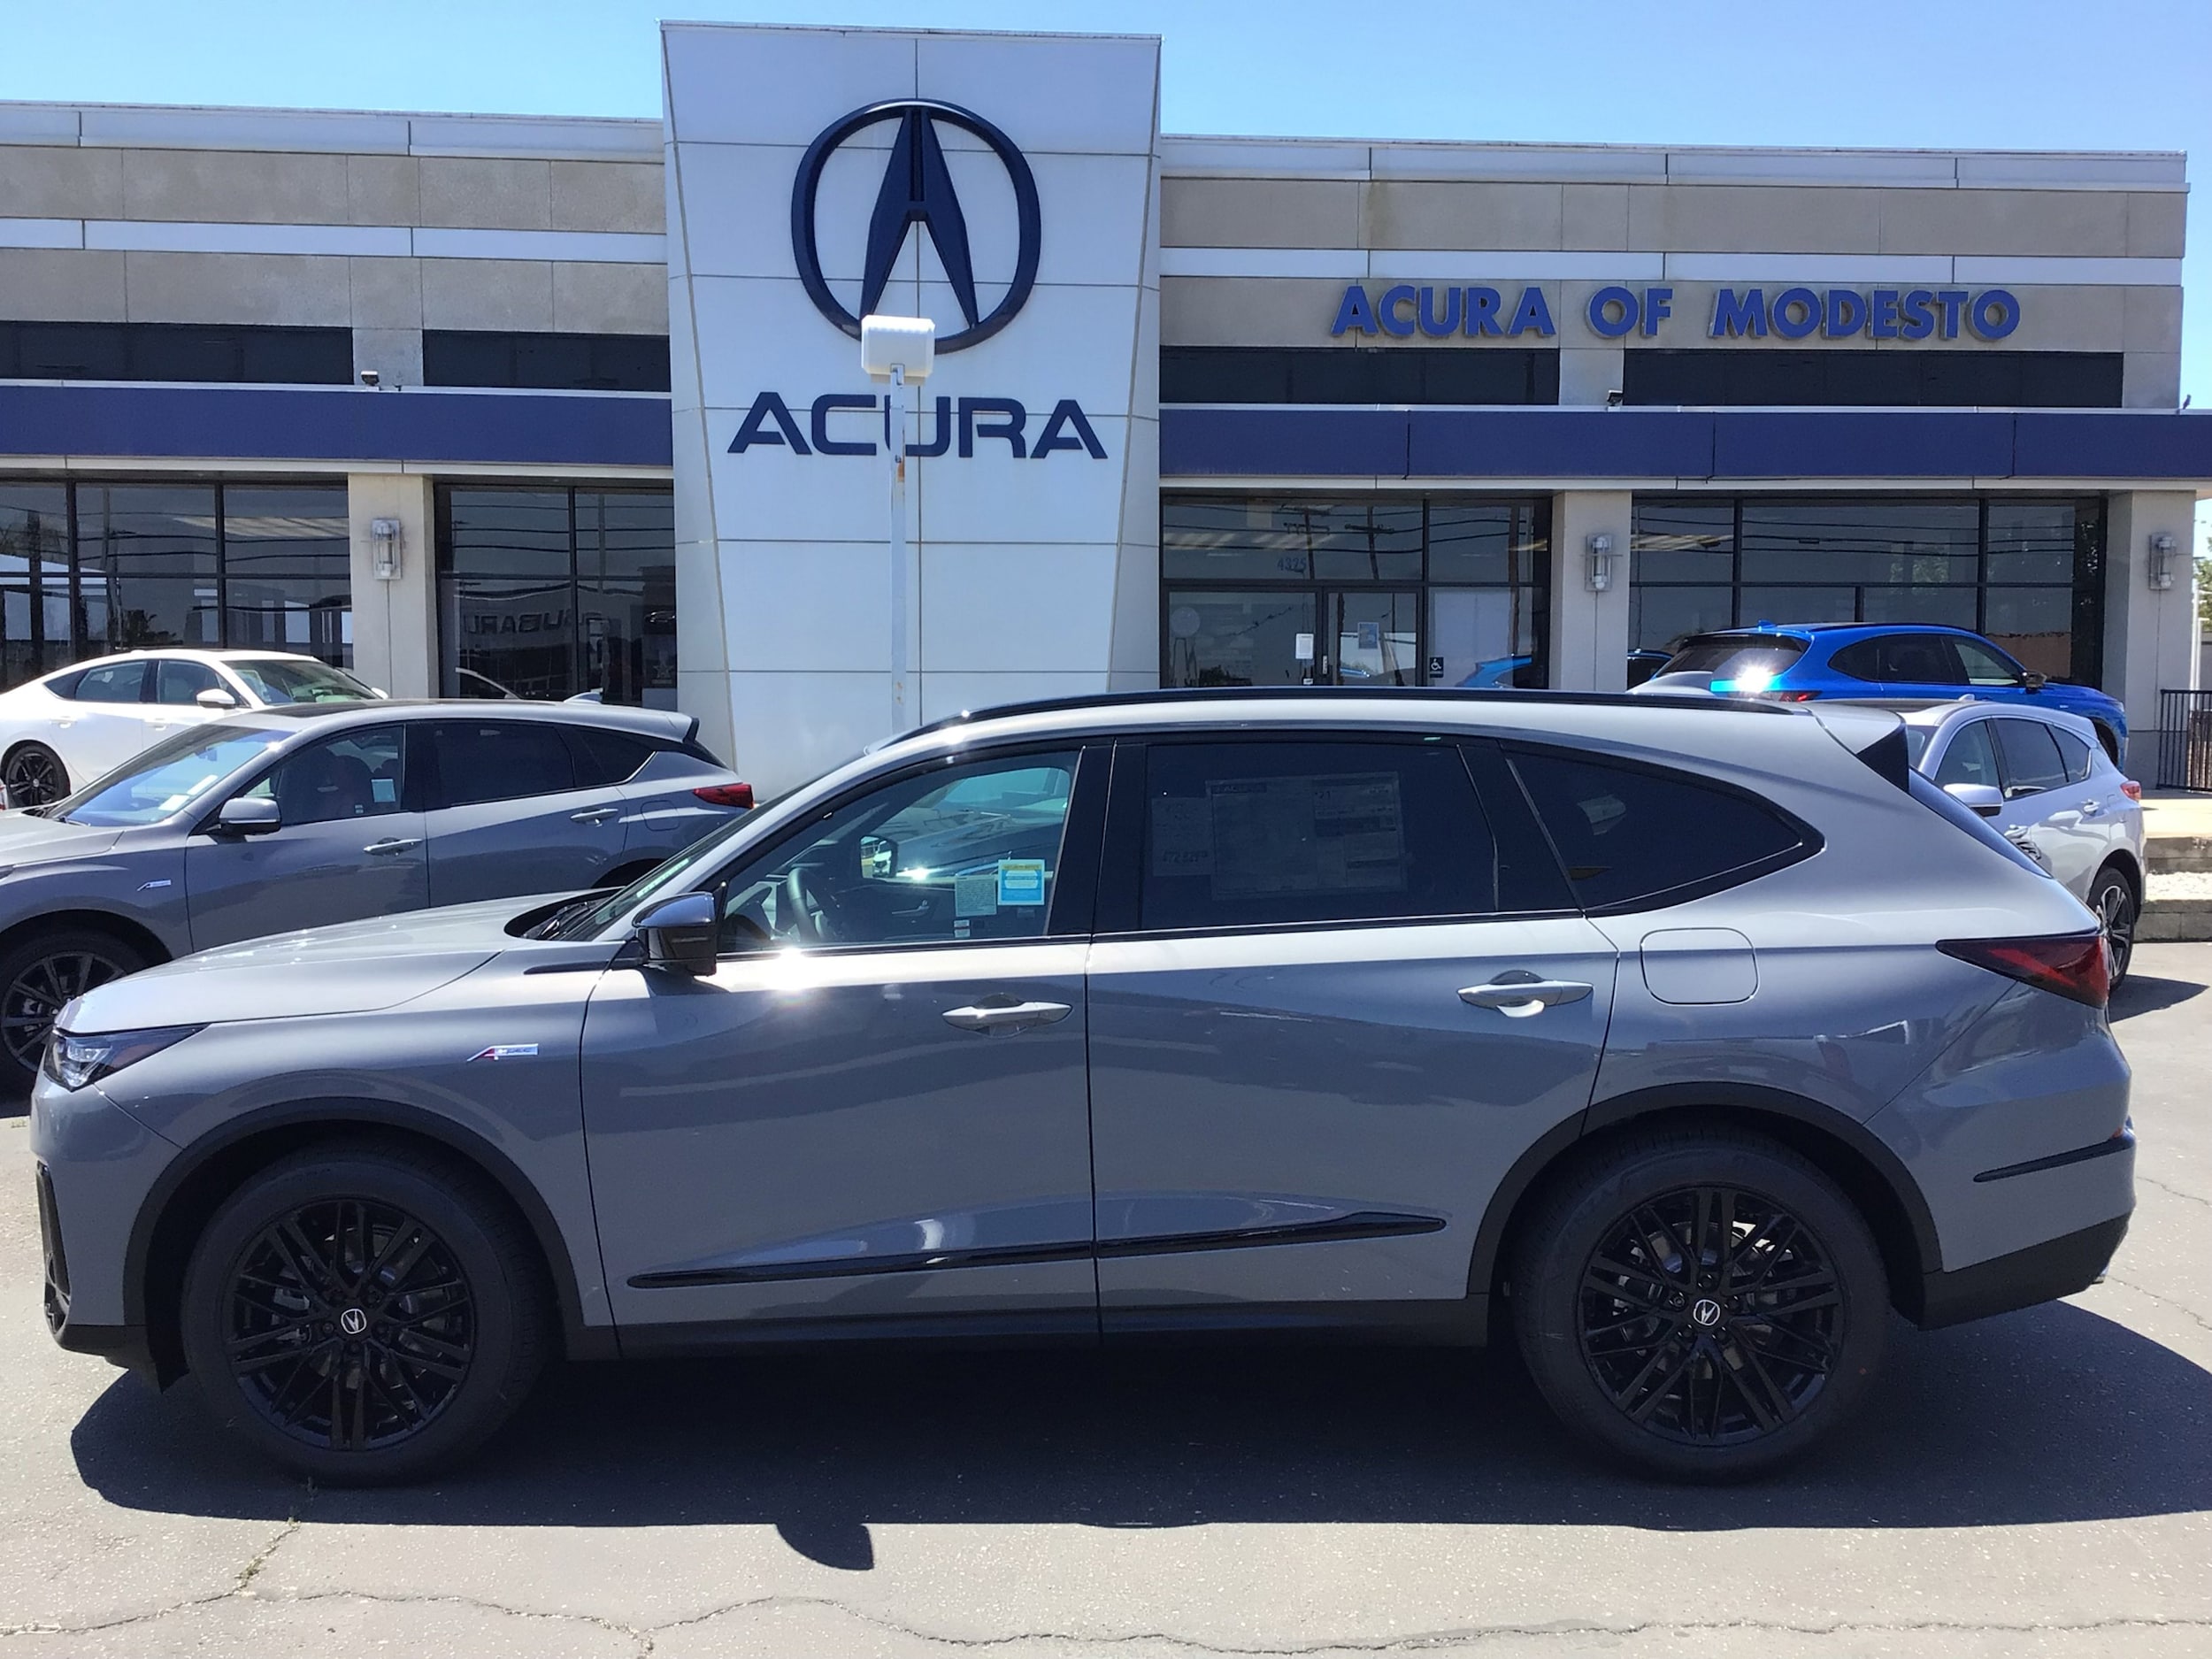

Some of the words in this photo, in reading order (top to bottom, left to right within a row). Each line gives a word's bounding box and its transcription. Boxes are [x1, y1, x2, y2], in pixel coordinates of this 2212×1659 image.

[1331, 285, 1557, 337] ACURA
[1588, 286, 1674, 338] OF
[1710, 288, 2021, 342] MODESTO
[727, 391, 1109, 459] ACURA
